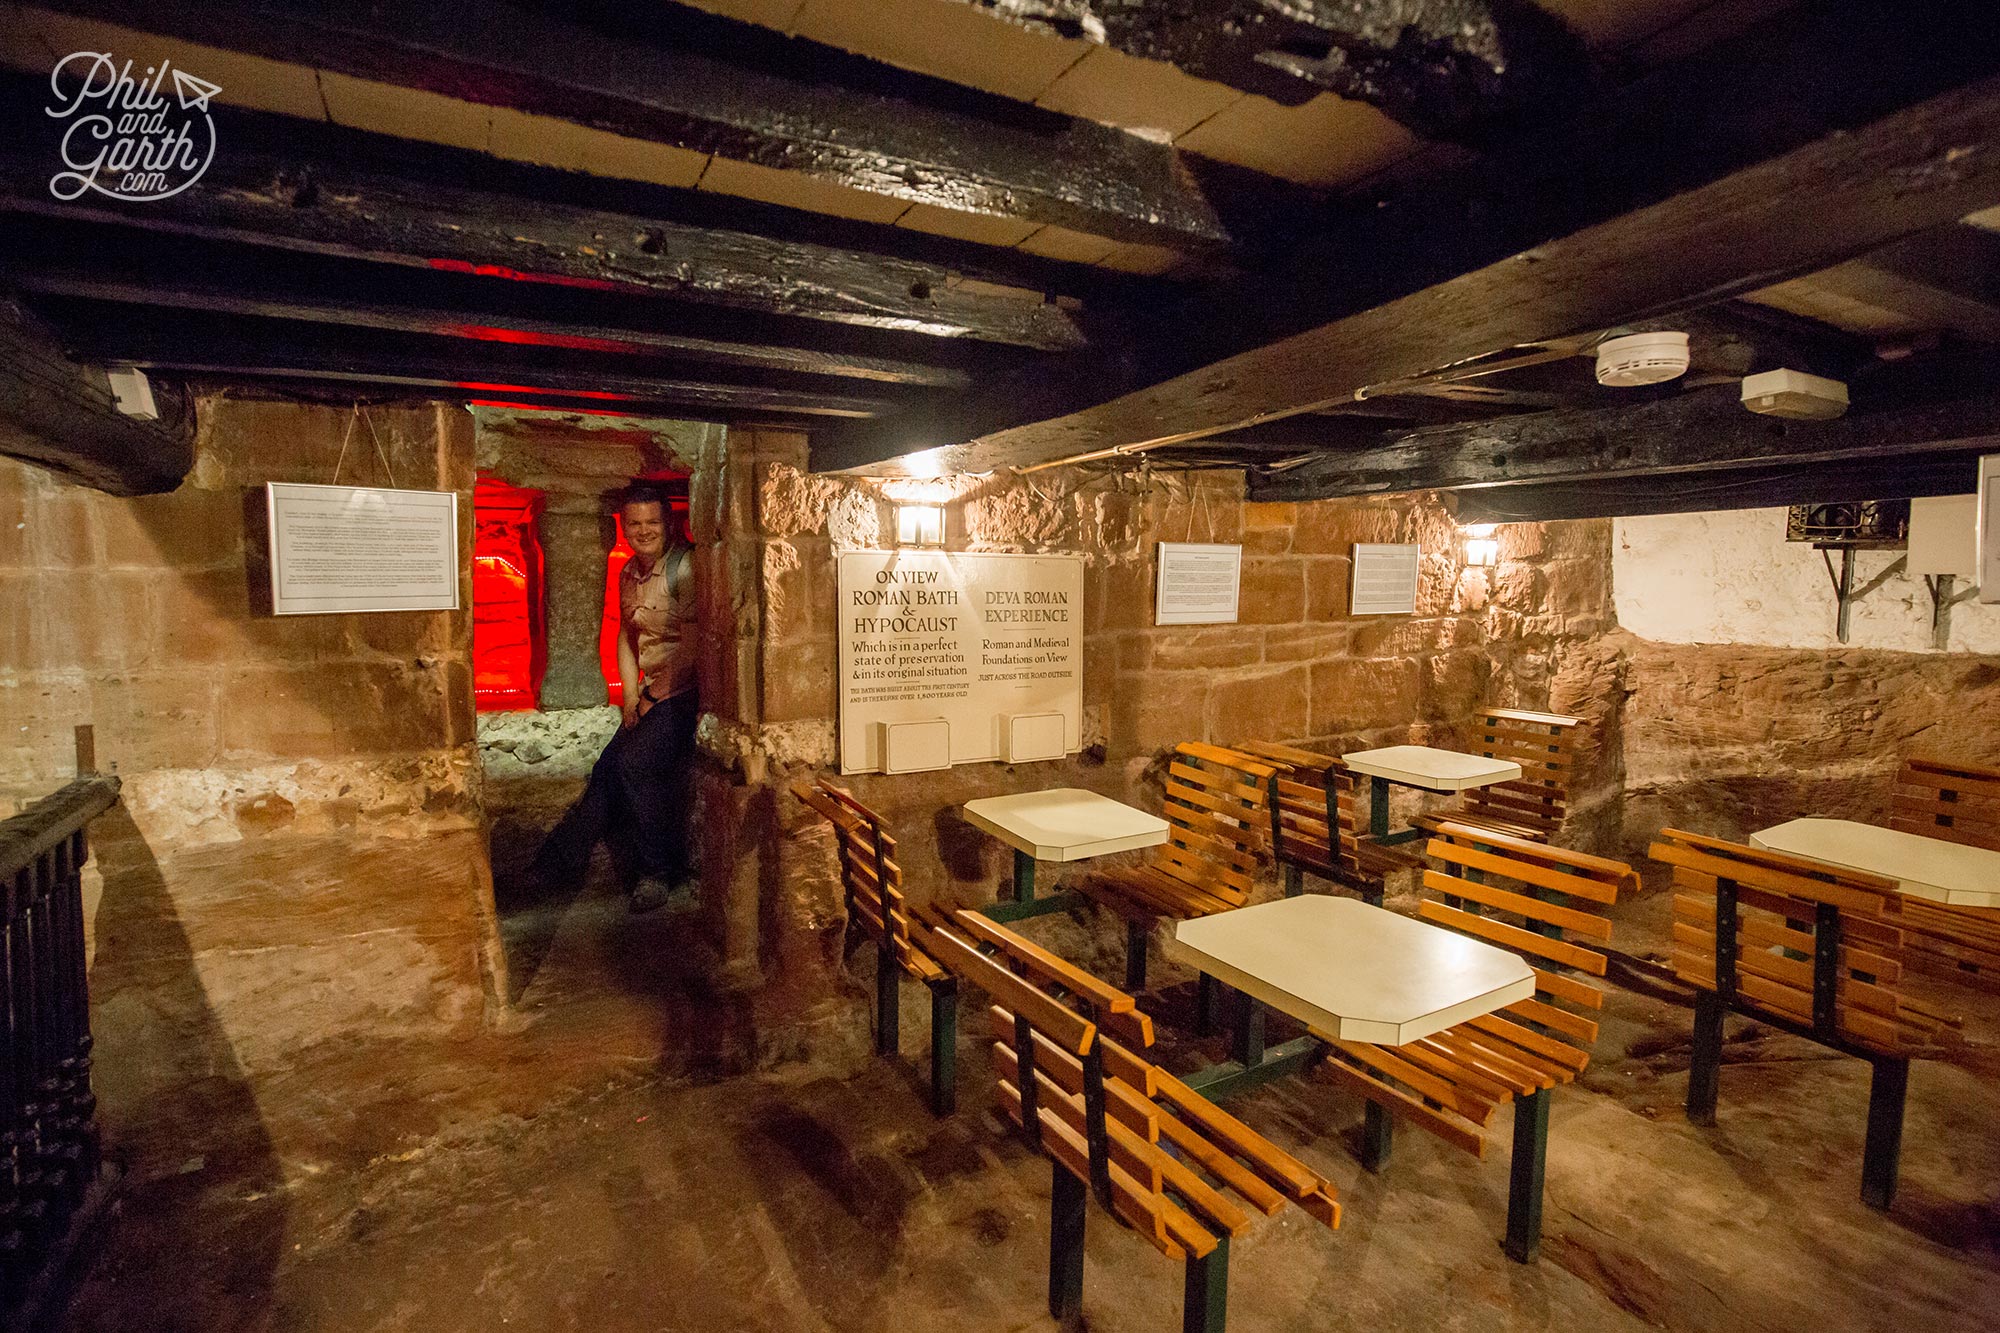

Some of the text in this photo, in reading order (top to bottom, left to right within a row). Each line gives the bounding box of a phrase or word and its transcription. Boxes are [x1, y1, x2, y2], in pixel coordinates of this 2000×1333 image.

[876, 570, 938, 584] ON VIEW
[853, 590, 958, 605] ROMAN BATH
[985, 592, 1068, 604] DEVA ROMAN
[902, 606, 916, 616] &
[985, 610, 1068, 622] EXPERIENCE
[854, 617, 958, 633] HYPOCAUST
[852, 636, 958, 653] Which is in a perfect
[982, 637, 1069, 650] Roman and Medieval
[854, 652, 964, 666] state of preservation
[982, 654, 1033, 665] Foundations
[1046, 652, 1068, 662] View
[873, 668, 886, 678] its
[887, 666, 925, 679] original
[926, 665, 968, 676] situation
